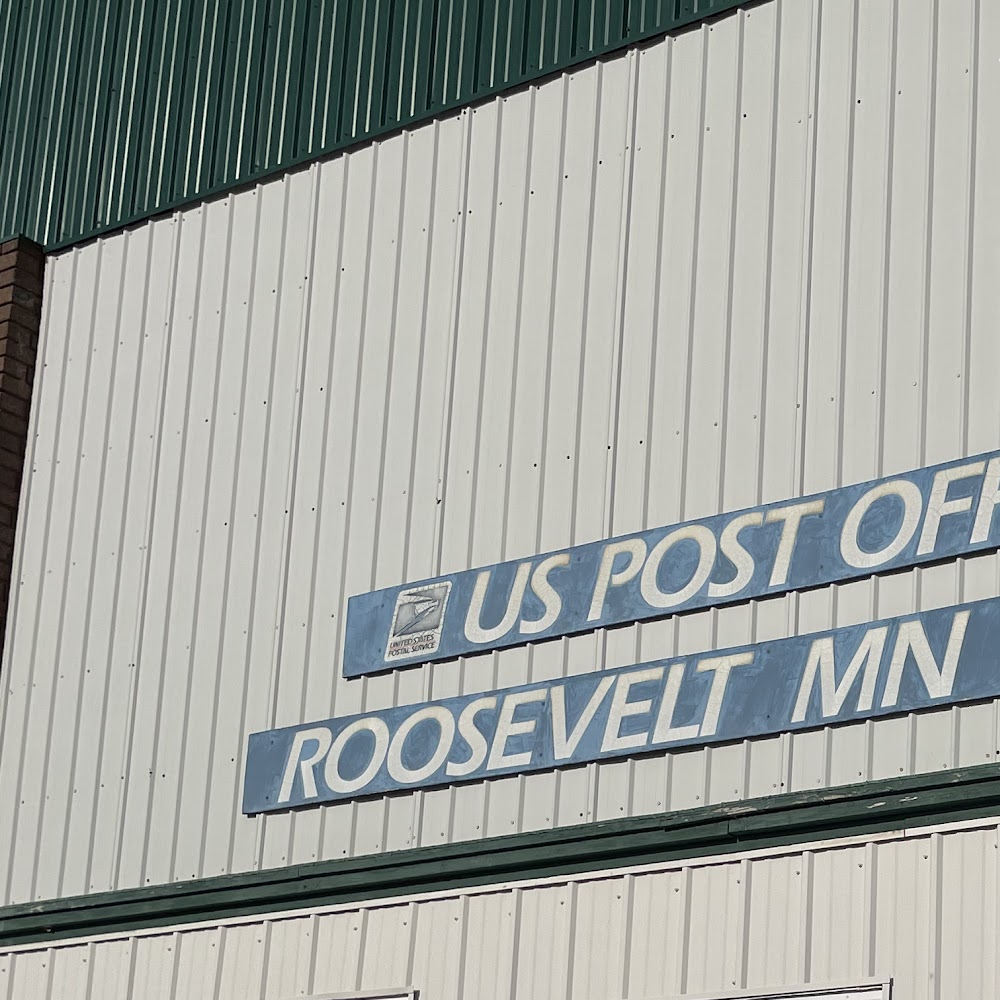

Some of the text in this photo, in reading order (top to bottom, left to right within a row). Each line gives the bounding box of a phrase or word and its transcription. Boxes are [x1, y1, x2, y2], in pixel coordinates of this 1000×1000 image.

[464, 553, 570, 644] US
[587, 499, 825, 622] POST
[388, 642, 435, 657] POSTAL SERVICE
[390, 634, 434, 648] UNITED STATES
[277, 652, 754, 804] ROOSEVELT
[791, 610, 971, 723] MN
